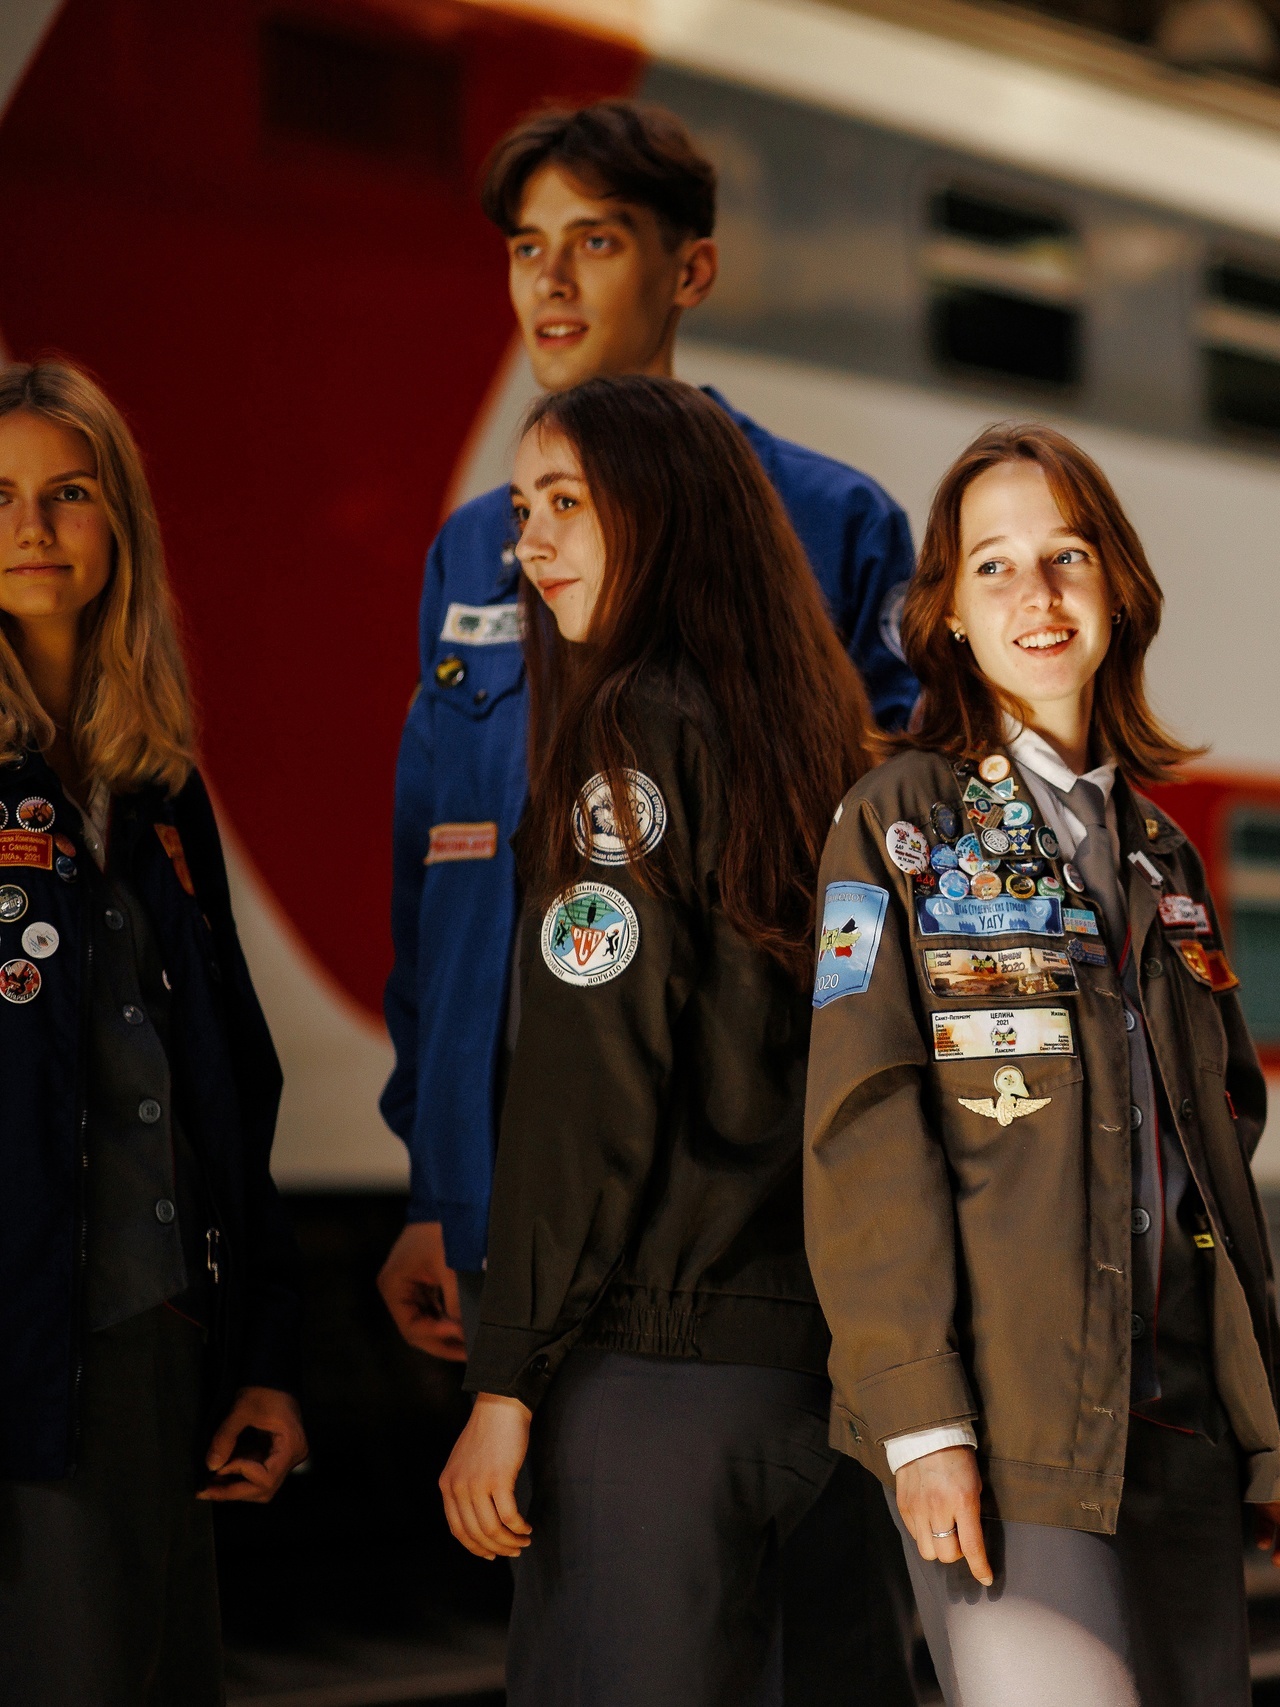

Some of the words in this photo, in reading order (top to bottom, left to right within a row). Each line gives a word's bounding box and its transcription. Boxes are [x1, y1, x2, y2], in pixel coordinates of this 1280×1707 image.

[607, 888, 626, 907] ШТАБ
[979, 914, 1004, 930] УдГУ
[621, 904, 637, 965] СТУДЕНЧЕСКИХ
[587, 964, 622, 984] ОТРЯДОВ
[1001, 962, 1026, 974] 2020
[990, 1012, 1014, 1020] ЦЕЛИНА
